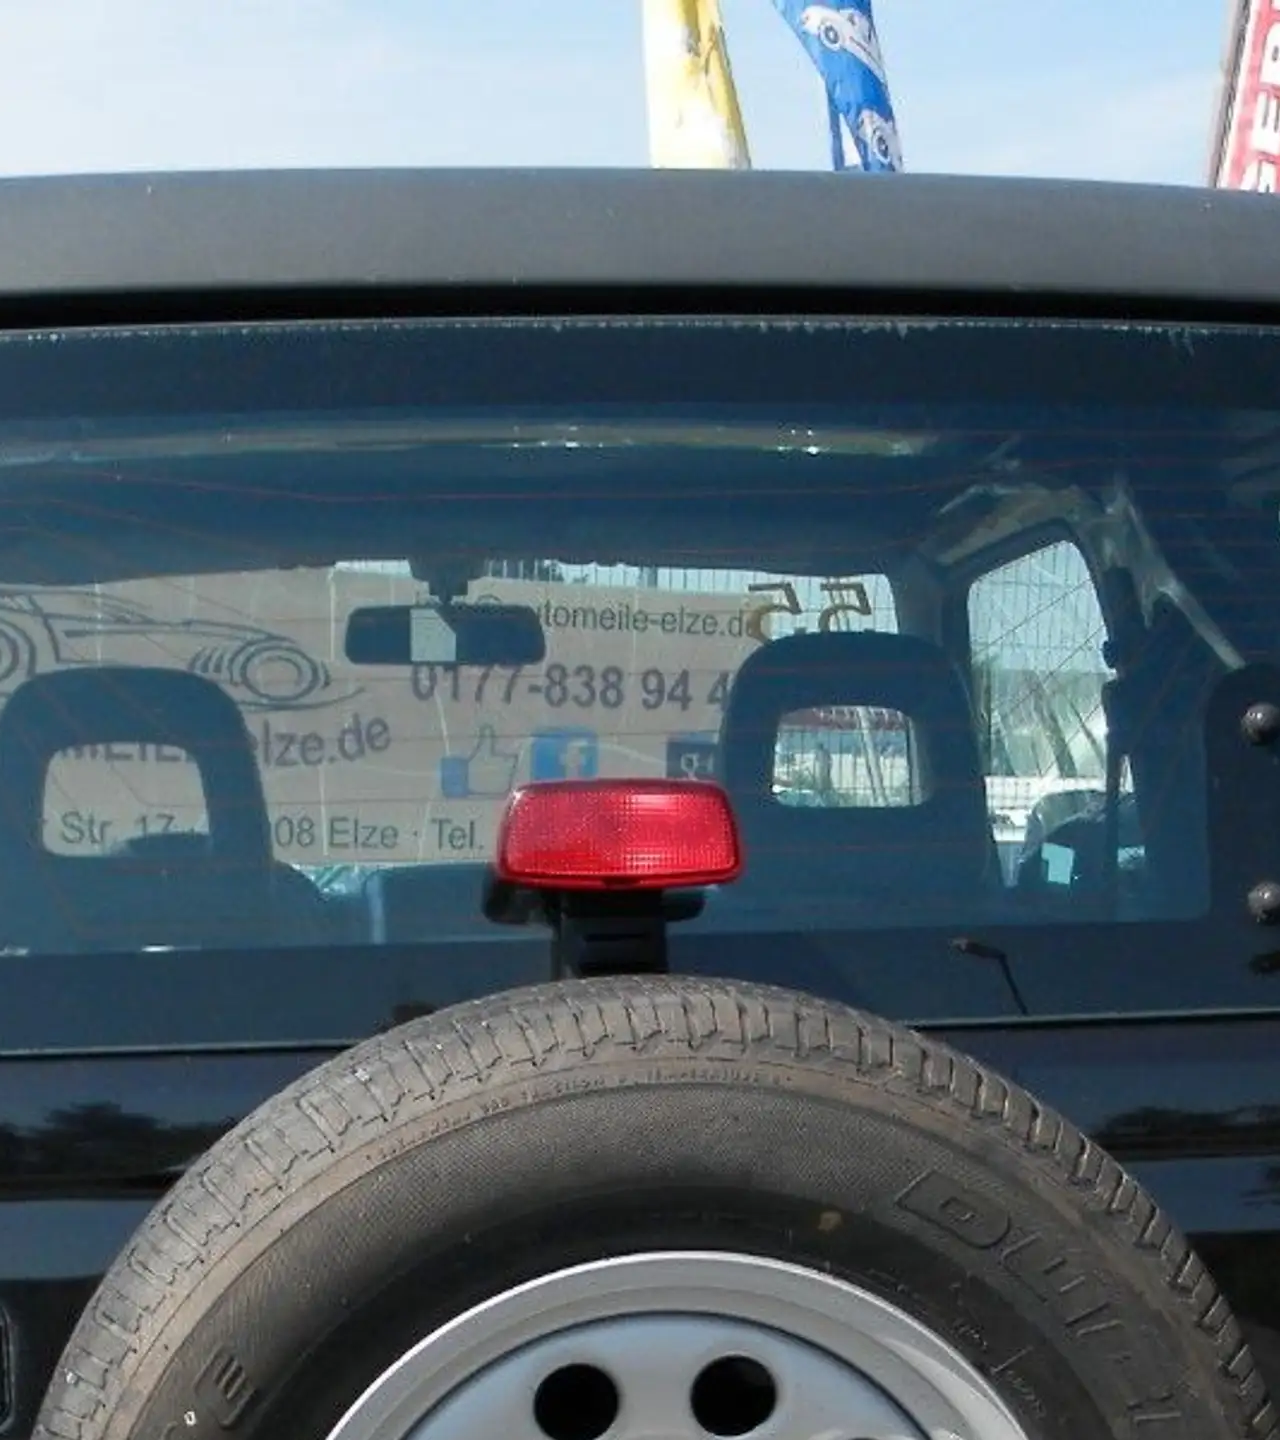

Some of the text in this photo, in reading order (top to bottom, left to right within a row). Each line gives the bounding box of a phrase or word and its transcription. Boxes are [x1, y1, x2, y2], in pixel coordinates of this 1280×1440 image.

[641, 666, 694, 712] 94
[707, 670, 733, 712] 4
[329, 816, 400, 849] Elze
[431, 817, 486, 850] Tel.
